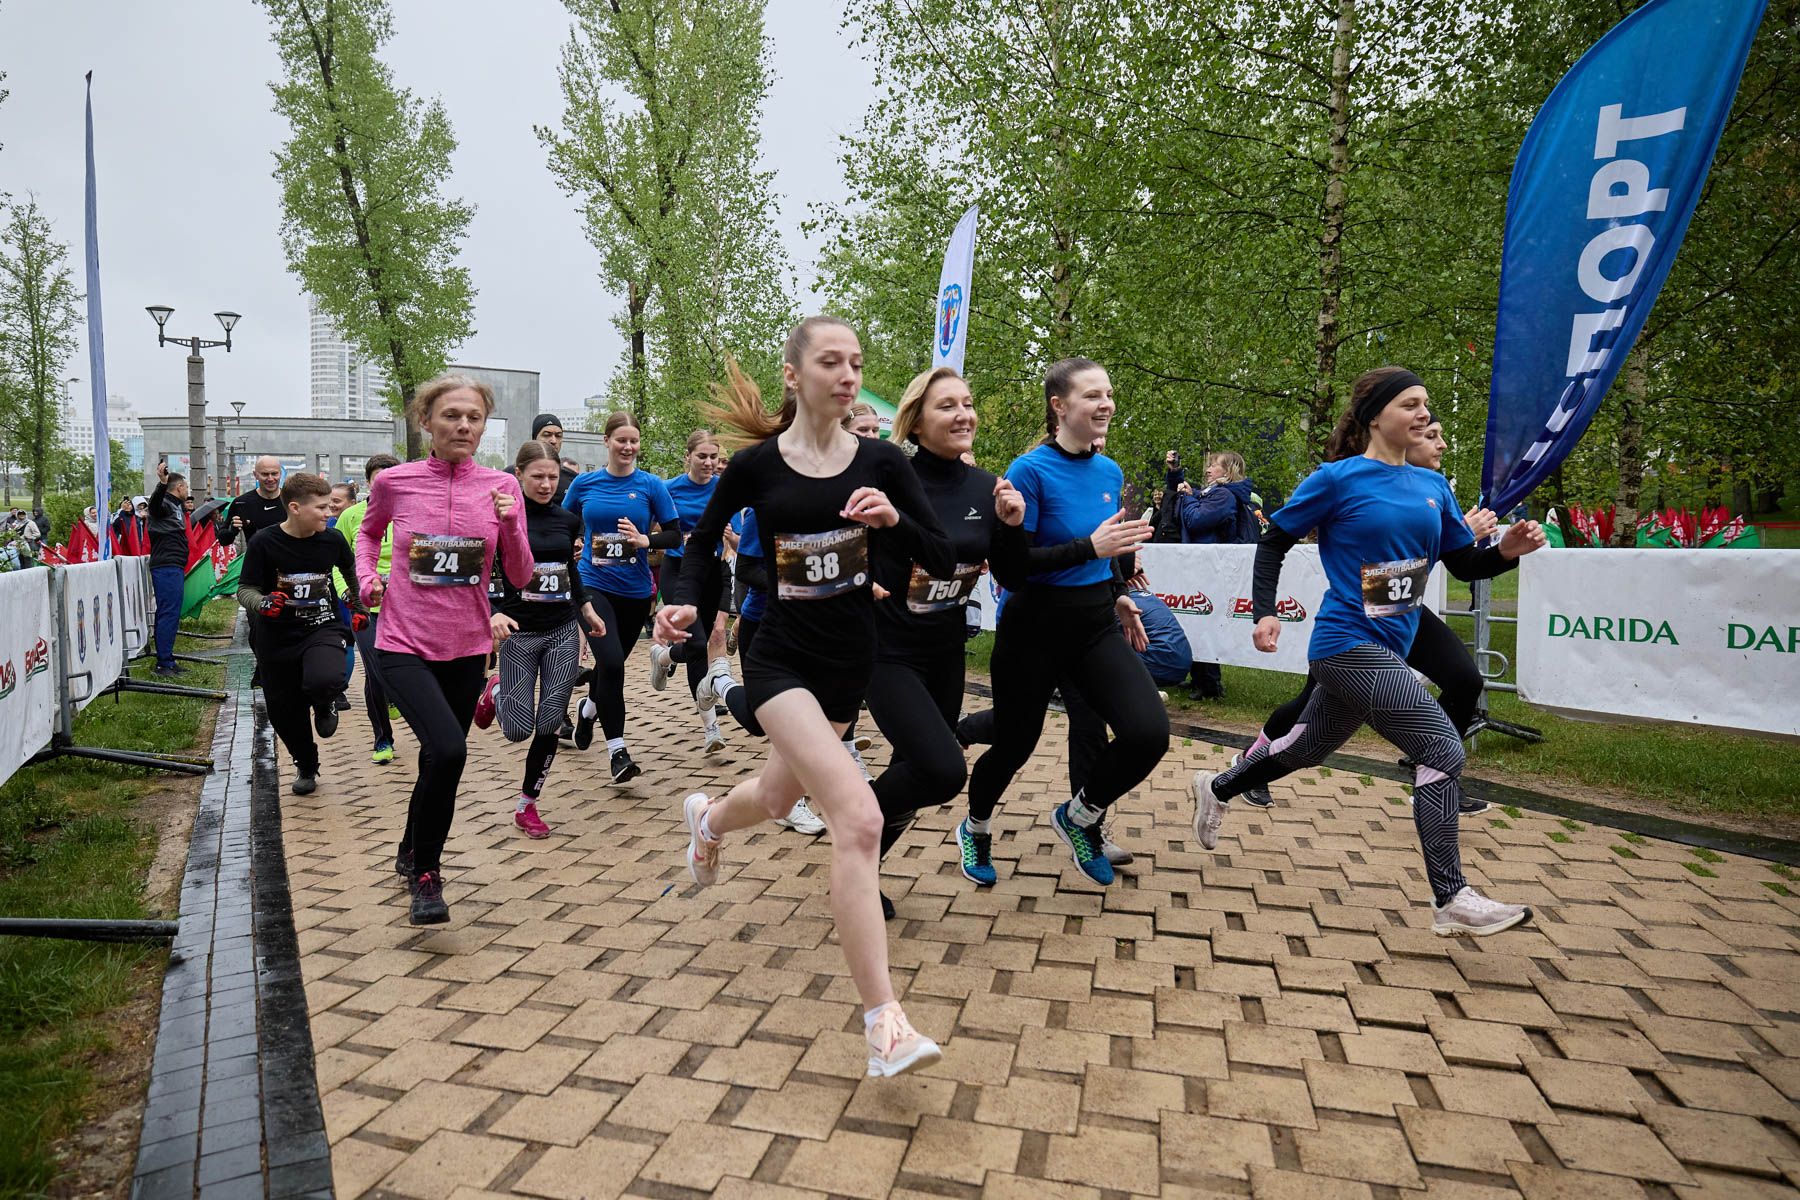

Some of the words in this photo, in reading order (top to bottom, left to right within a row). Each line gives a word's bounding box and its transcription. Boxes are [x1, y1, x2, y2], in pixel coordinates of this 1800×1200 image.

[606, 543, 623, 557] 28
[433, 551, 459, 573] 24
[805, 552, 840, 583] 38
[294, 584, 311, 599] 37
[539, 575, 559, 592] 29
[926, 579, 963, 602] 750
[1388, 576, 1412, 601] 32
[1548, 614, 1680, 646] DARIDA
[533, 768, 550, 790] FILA
